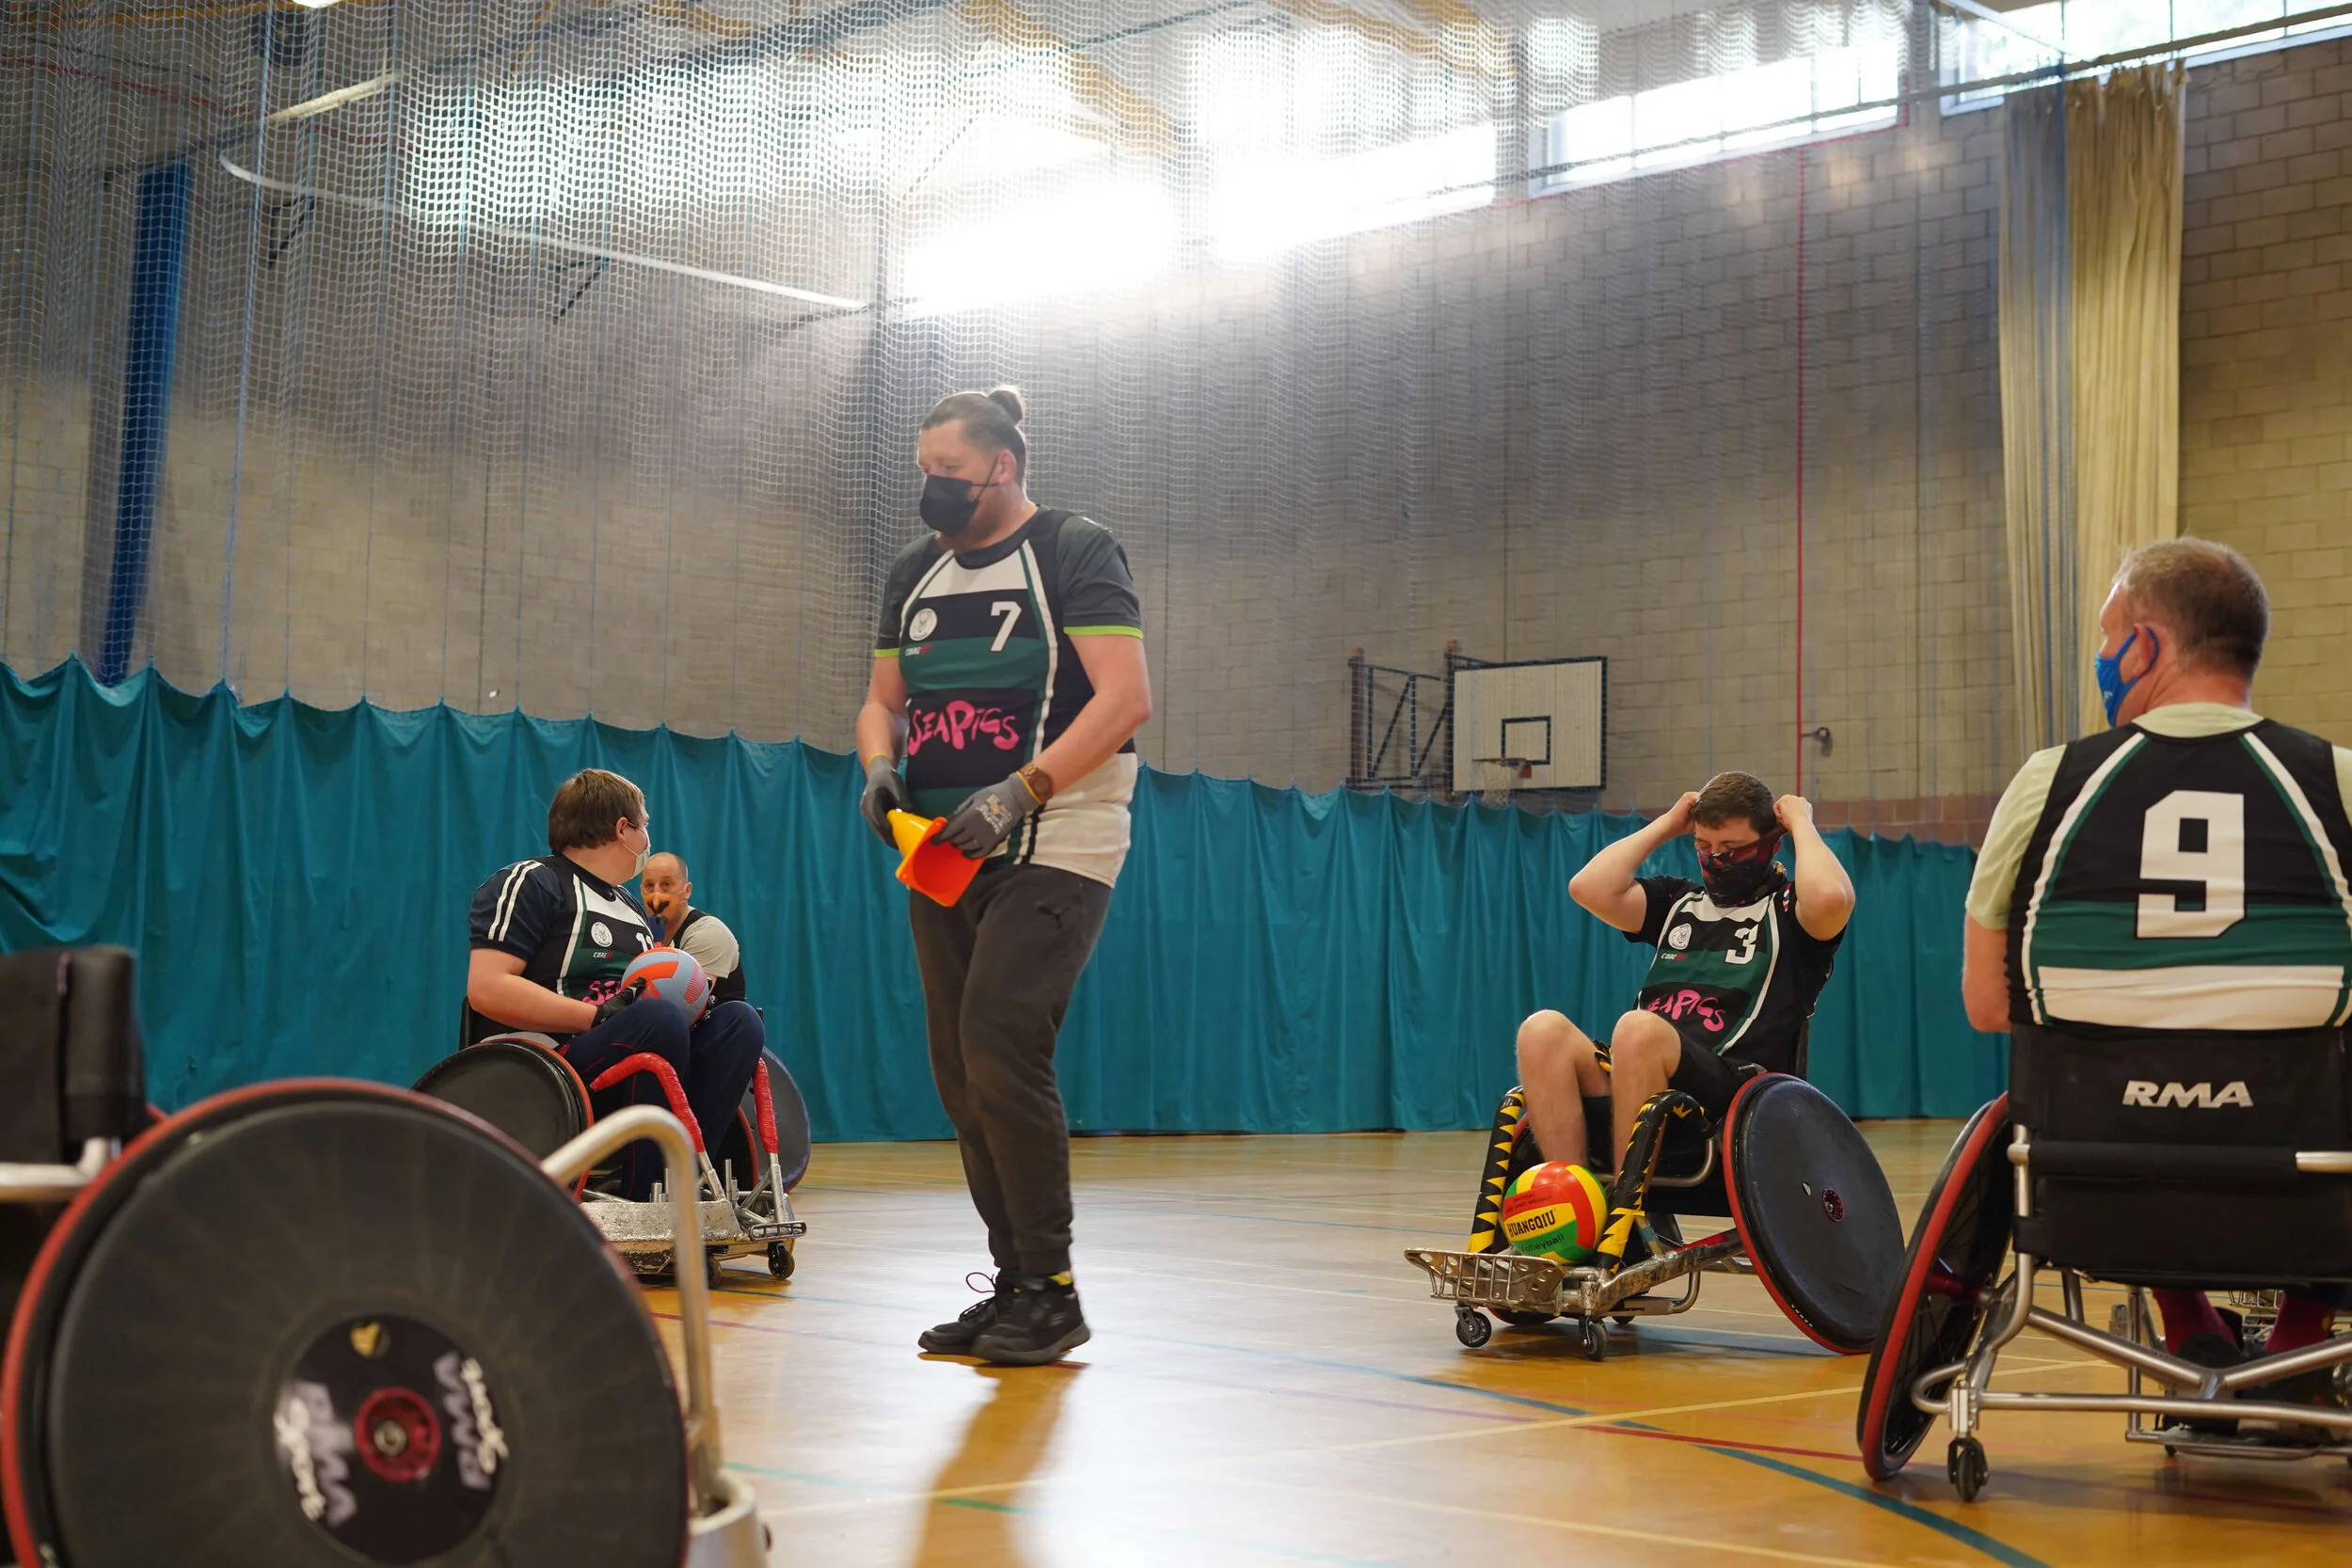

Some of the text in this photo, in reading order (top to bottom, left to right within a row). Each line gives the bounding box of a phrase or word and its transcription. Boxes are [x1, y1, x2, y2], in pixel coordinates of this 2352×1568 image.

[990, 601, 1023, 652] 7
[2136, 789, 2246, 939] 9
[1724, 924, 1759, 965] 3
[1647, 990, 1725, 1032] EAPIGS
[2122, 1080, 2254, 1109] RMA
[1506, 1210, 1556, 1238] HUANGQIU
[1519, 1233, 1565, 1252] Volleyball
